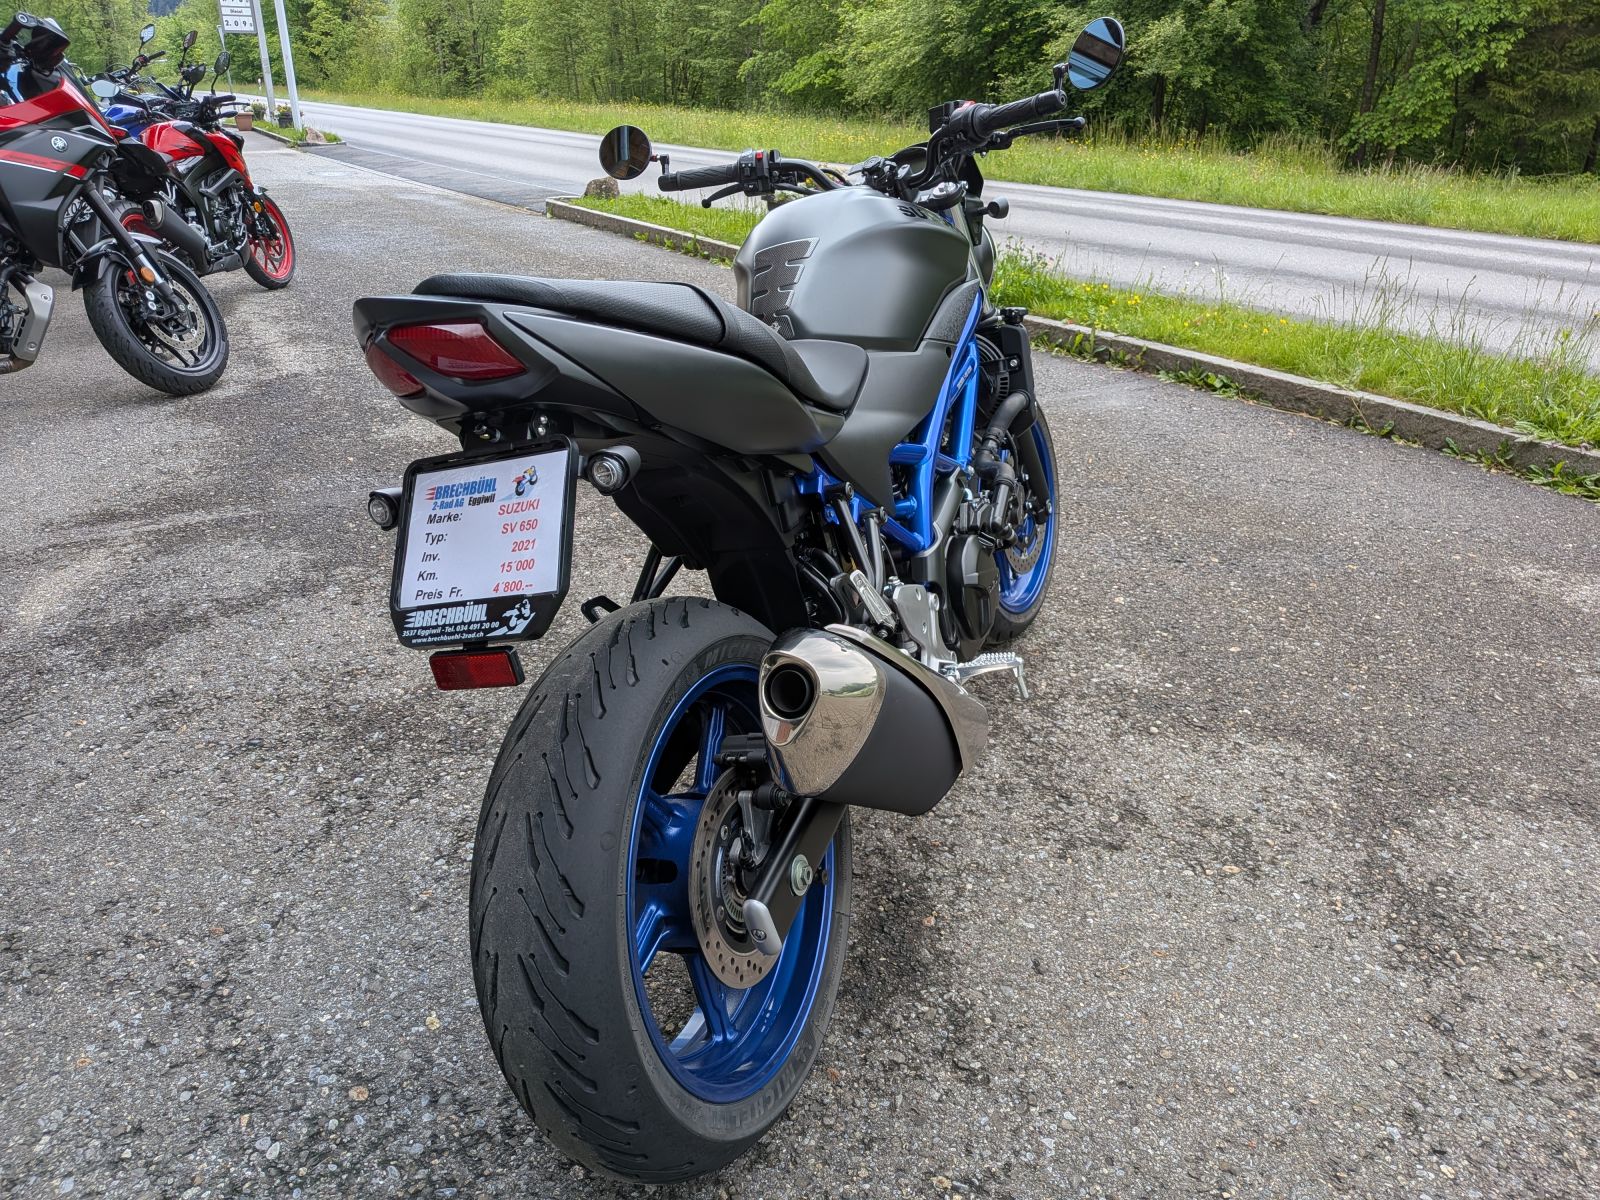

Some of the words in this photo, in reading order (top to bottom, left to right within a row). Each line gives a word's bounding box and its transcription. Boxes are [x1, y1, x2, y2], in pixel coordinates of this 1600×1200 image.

[433, 476, 497, 501] BRECHBÜHL
[426, 511, 463, 525] Marke:
[498, 499, 540, 516] SUZUKI
[431, 499, 454, 511] 2-Rad
[454, 498, 465, 508] AG
[468, 493, 496, 507] Eggiwil
[425, 532, 448, 546] Typ:
[501, 522, 518, 535] SV
[519, 519, 538, 532] 650
[421, 551, 441, 563] Inv.
[511, 538, 536, 553] 2021
[417, 570, 438, 582] Km.
[415, 588, 443, 601] Preis
[449, 586, 463, 599] Fr.
[414, 602, 488, 629] BRECHBÜHL
[402, 629, 417, 637] 3537
[417, 627, 441, 637] Eggiwil
[456, 624, 468, 633] 034
[468, 623, 480, 631] 491
[481, 622, 490, 630] 20
[490, 621, 500, 629] 00
[411, 631, 484, 644] www.brechbuehl-2rad.ch
